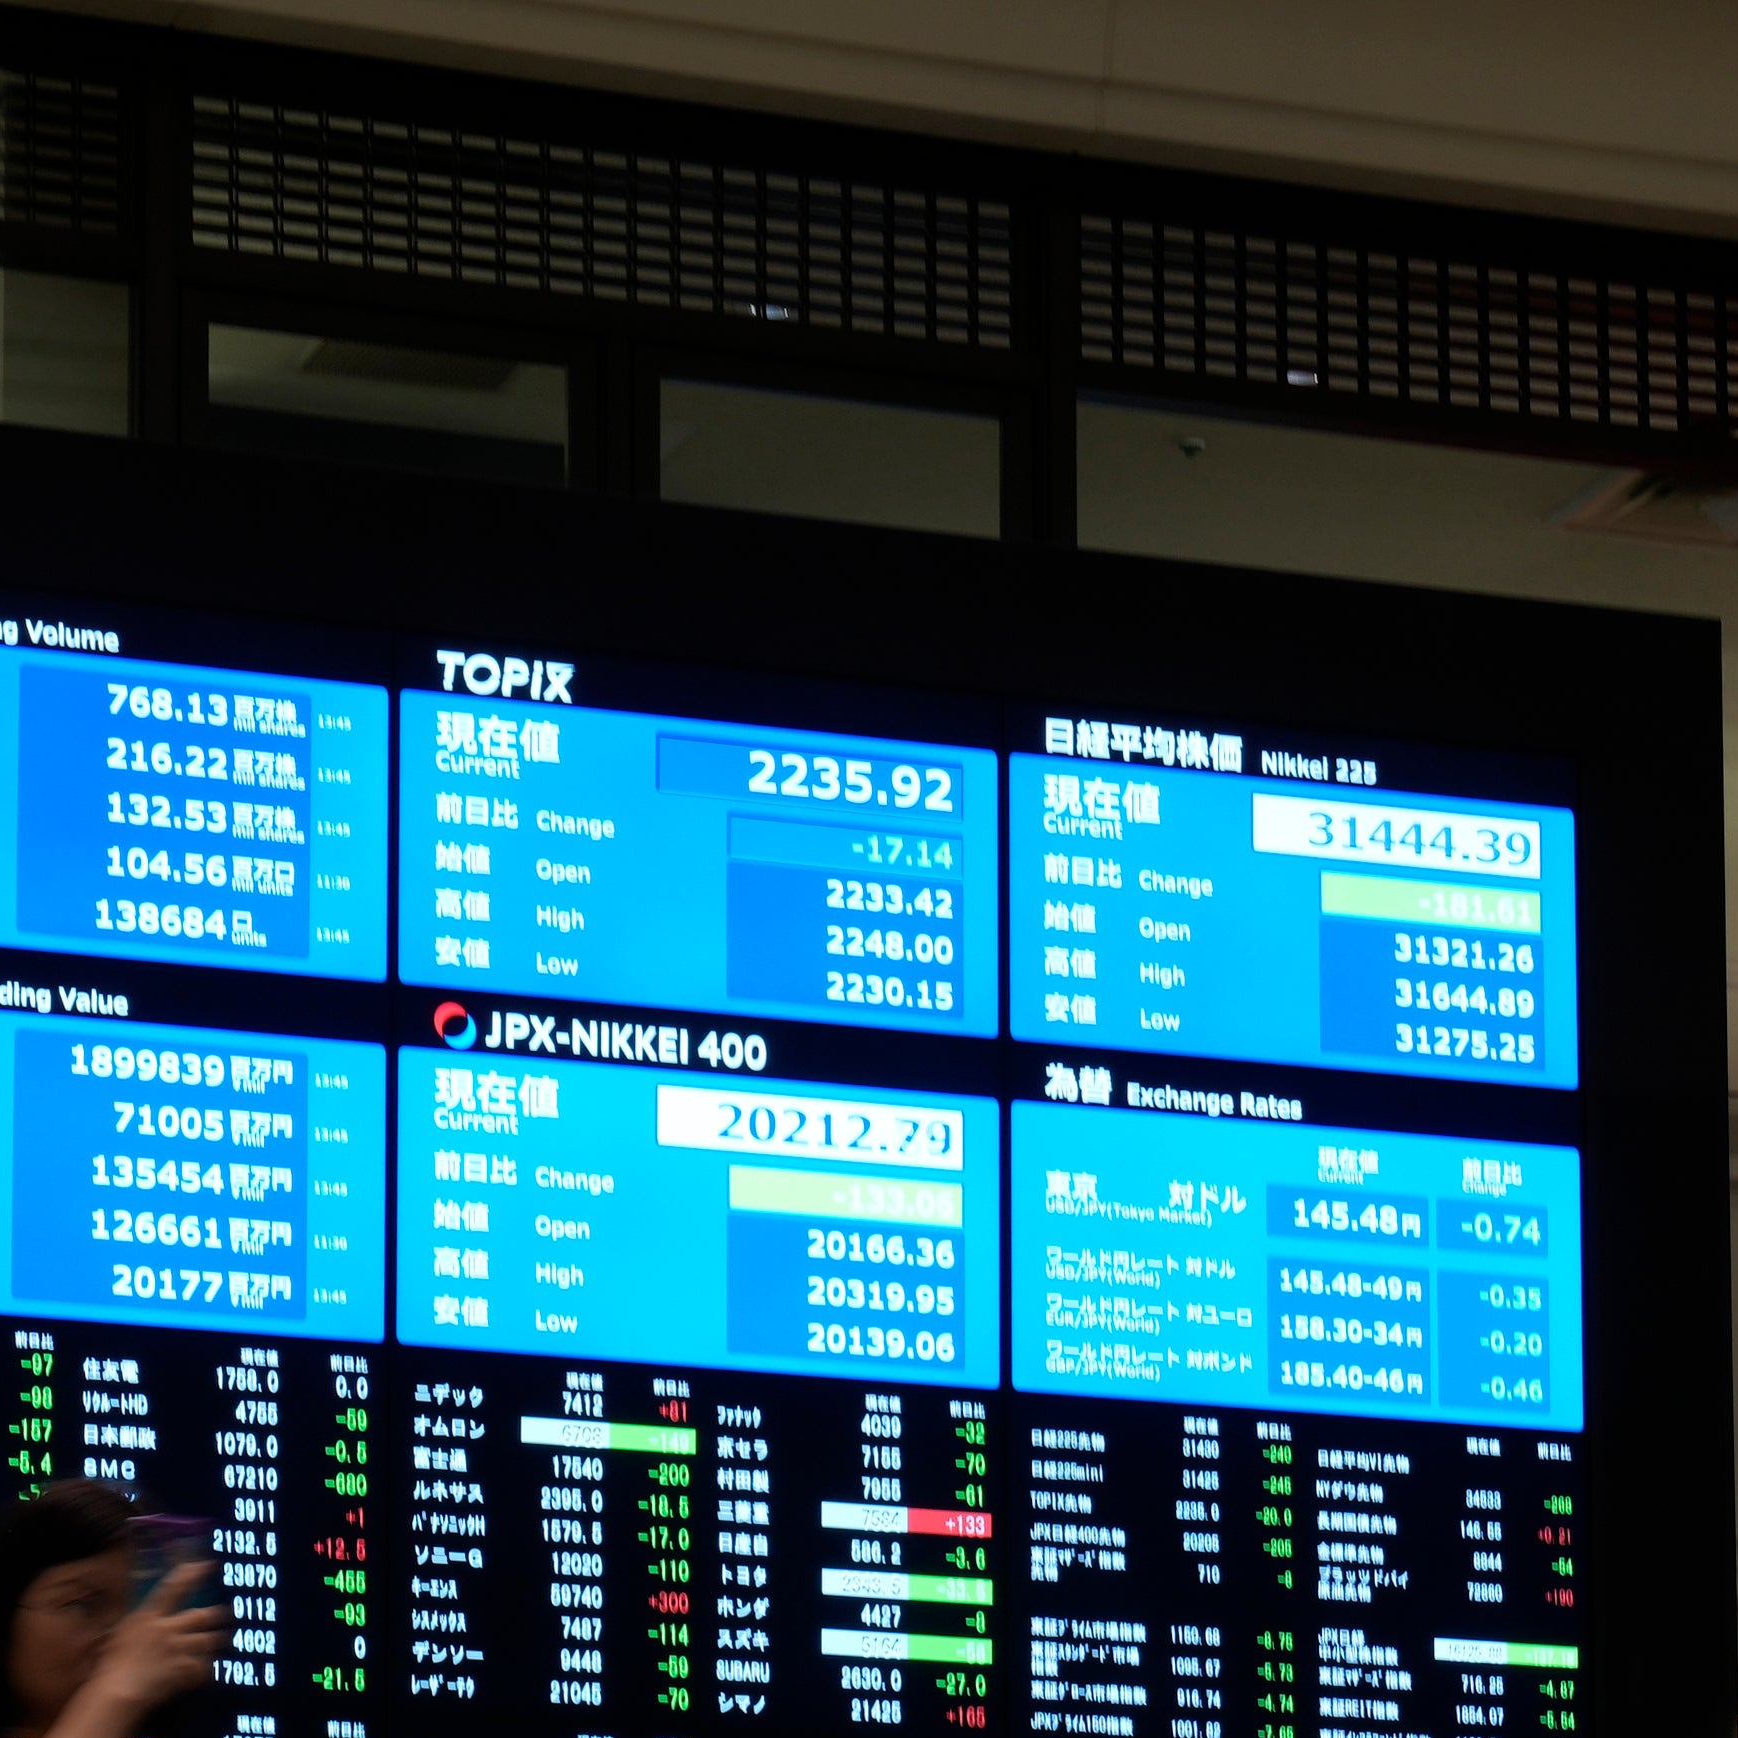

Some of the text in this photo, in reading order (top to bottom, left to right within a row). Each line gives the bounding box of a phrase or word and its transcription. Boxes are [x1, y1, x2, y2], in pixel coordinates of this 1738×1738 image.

[25, 618, 120, 653] Volume
[436, 649, 576, 705] TOPIX
[107, 682, 228, 727] 768.13
[106, 737, 228, 780] 216.22
[435, 710, 953, 813] 現在値 2235.92
[435, 750, 521, 780] Current
[1044, 716, 1377, 786] 日経平均株価 Nikkei 225
[107, 791, 228, 834] 132.53
[435, 791, 953, 870] 前日比 Change -17.14
[1043, 773, 1532, 866] 現在値 31444.39
[1043, 812, 1123, 841] Current
[107, 845, 228, 887] 104.56
[435, 840, 954, 920] 始値 Open 2233.42
[1043, 852, 1533, 927] 前日比 Change -181.61
[95, 898, 226, 941] 138684
[434, 887, 954, 966] 高値 High 2248.00
[1043, 899, 1535, 974] 始値 Open 31321.26
[434, 934, 954, 1011] 安値 Low 2230.15
[1044, 946, 1535, 1019] 高値 High 31644.89
[58, 986, 129, 1017] Value
[484, 1010, 768, 1072] JPX-NIKKEI 400
[1044, 991, 1535, 1064] 安値 Low 31275.25
[71, 1043, 225, 1087] 1899839
[434, 1067, 953, 1156] 現在値 20212.79
[1044, 1061, 1303, 1122] 為替 Exchange Rates
[113, 1101, 225, 1142] 71005
[433, 1107, 519, 1136] Current
[92, 1154, 225, 1195] 135454
[1317, 1144, 1379, 1175] 現在値
[1462, 1156, 1522, 1187] 前日比
[433, 1149, 956, 1221] 前日比 Change -133.06
[91, 1208, 223, 1249] 126661
[1045, 1169, 1541, 1246] 東京 対ドル 145.48 -0.74
[433, 1198, 956, 1270] 始値 Open 20166.36
[112, 1263, 223, 1303] 20177
[433, 1246, 956, 1316] 高値 High 20319.95
[1046, 1245, 1542, 1312] ワールド円レート 対ドル 145.48-49 -0.35
[433, 1294, 956, 1363] 安値 Low 20139.06
[1046, 1292, 1543, 1358] ワールド円レート 対ユーロ 158.30-34 -0.20
[1046, 1339, 1181, 1370] ワールド円レート
[1280, 1360, 1404, 1394] 185.40-46
[1480, 1375, 1544, 1404] -0.46
[83, 1422, 158, 1452] 日本郵政
[413, 1414, 486, 1440] オムロン
[413, 1480, 485, 1505] ルネサス
[945, 1514, 986, 1536] +133
[721, 1564, 768, 1587] トヨタ
[716, 1596, 771, 1619] ホンダ
[716, 1628, 770, 1653] スズキ
[715, 1659, 770, 1685] SUBARU
